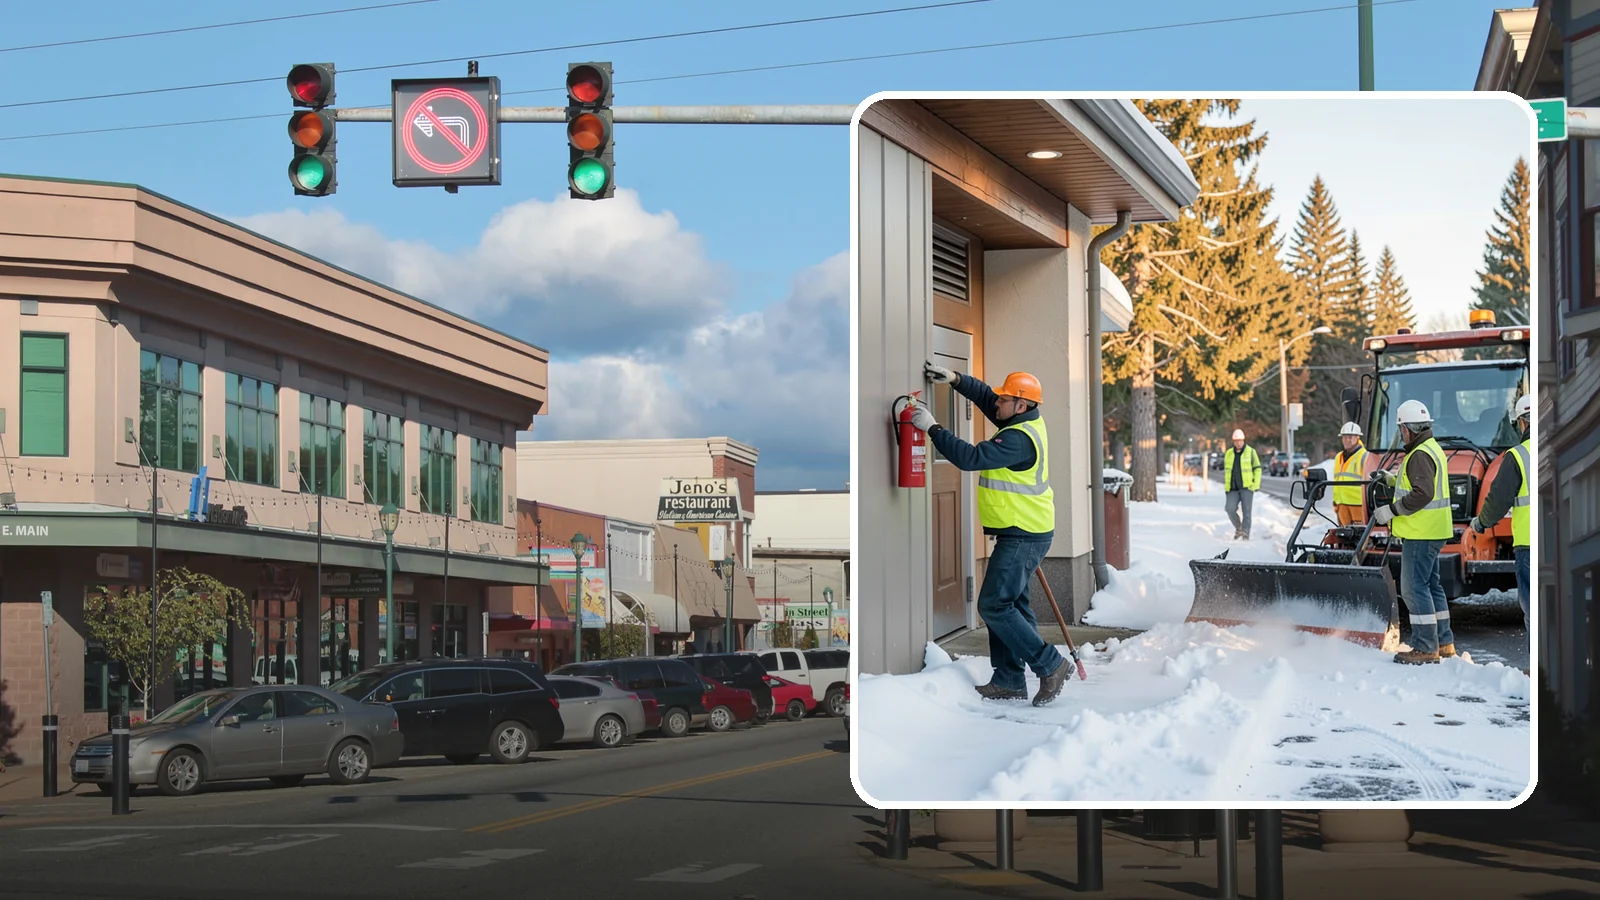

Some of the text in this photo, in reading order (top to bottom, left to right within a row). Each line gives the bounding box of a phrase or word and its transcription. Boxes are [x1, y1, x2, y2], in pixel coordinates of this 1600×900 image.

[669, 480, 727, 494] Jeno's
[665, 496, 731, 509] restaurant
[658, 509, 681, 519] Italian
[685, 509, 714, 519] American
[714, 509, 738, 519] Cuisine
[2, 525, 49, 536] E. MAIN
[797, 607, 829, 617] Street
[791, 619, 824, 627] lass
